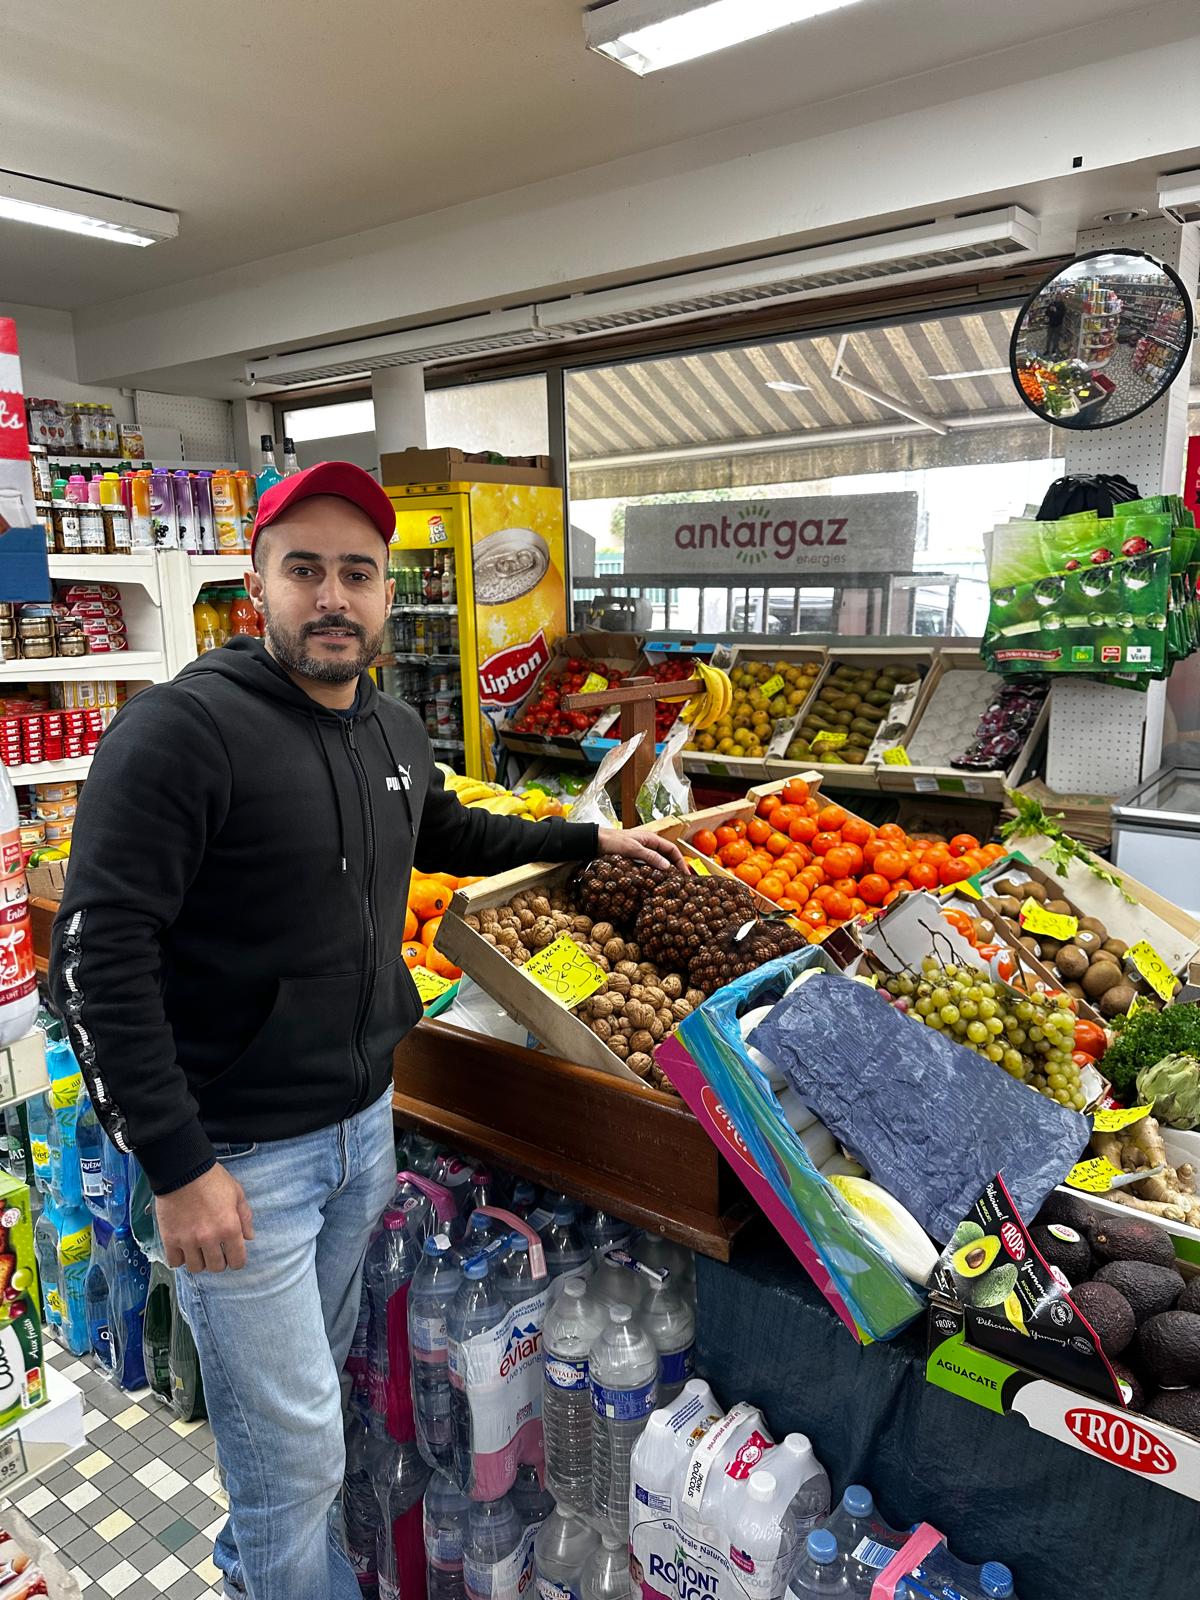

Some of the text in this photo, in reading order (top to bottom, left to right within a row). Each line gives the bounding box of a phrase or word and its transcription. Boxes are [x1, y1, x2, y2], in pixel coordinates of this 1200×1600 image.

[675, 516, 849, 560] antargaz
[796, 552, 847, 568] energies
[480, 650, 542, 696] Lipton
[1001, 1222, 1026, 1260] TROPS
[935, 1318, 957, 1330] TROPS
[28, 1338, 39, 1359] Aux
[546, 1364, 583, 1379] RISTALINE
[936, 1358, 998, 1392] AGUACATE
[1071, 1411, 1171, 1474] TROPS
[687, 1460, 703, 1498] ROUCOUS
[695, 1473, 704, 1493] MONT
